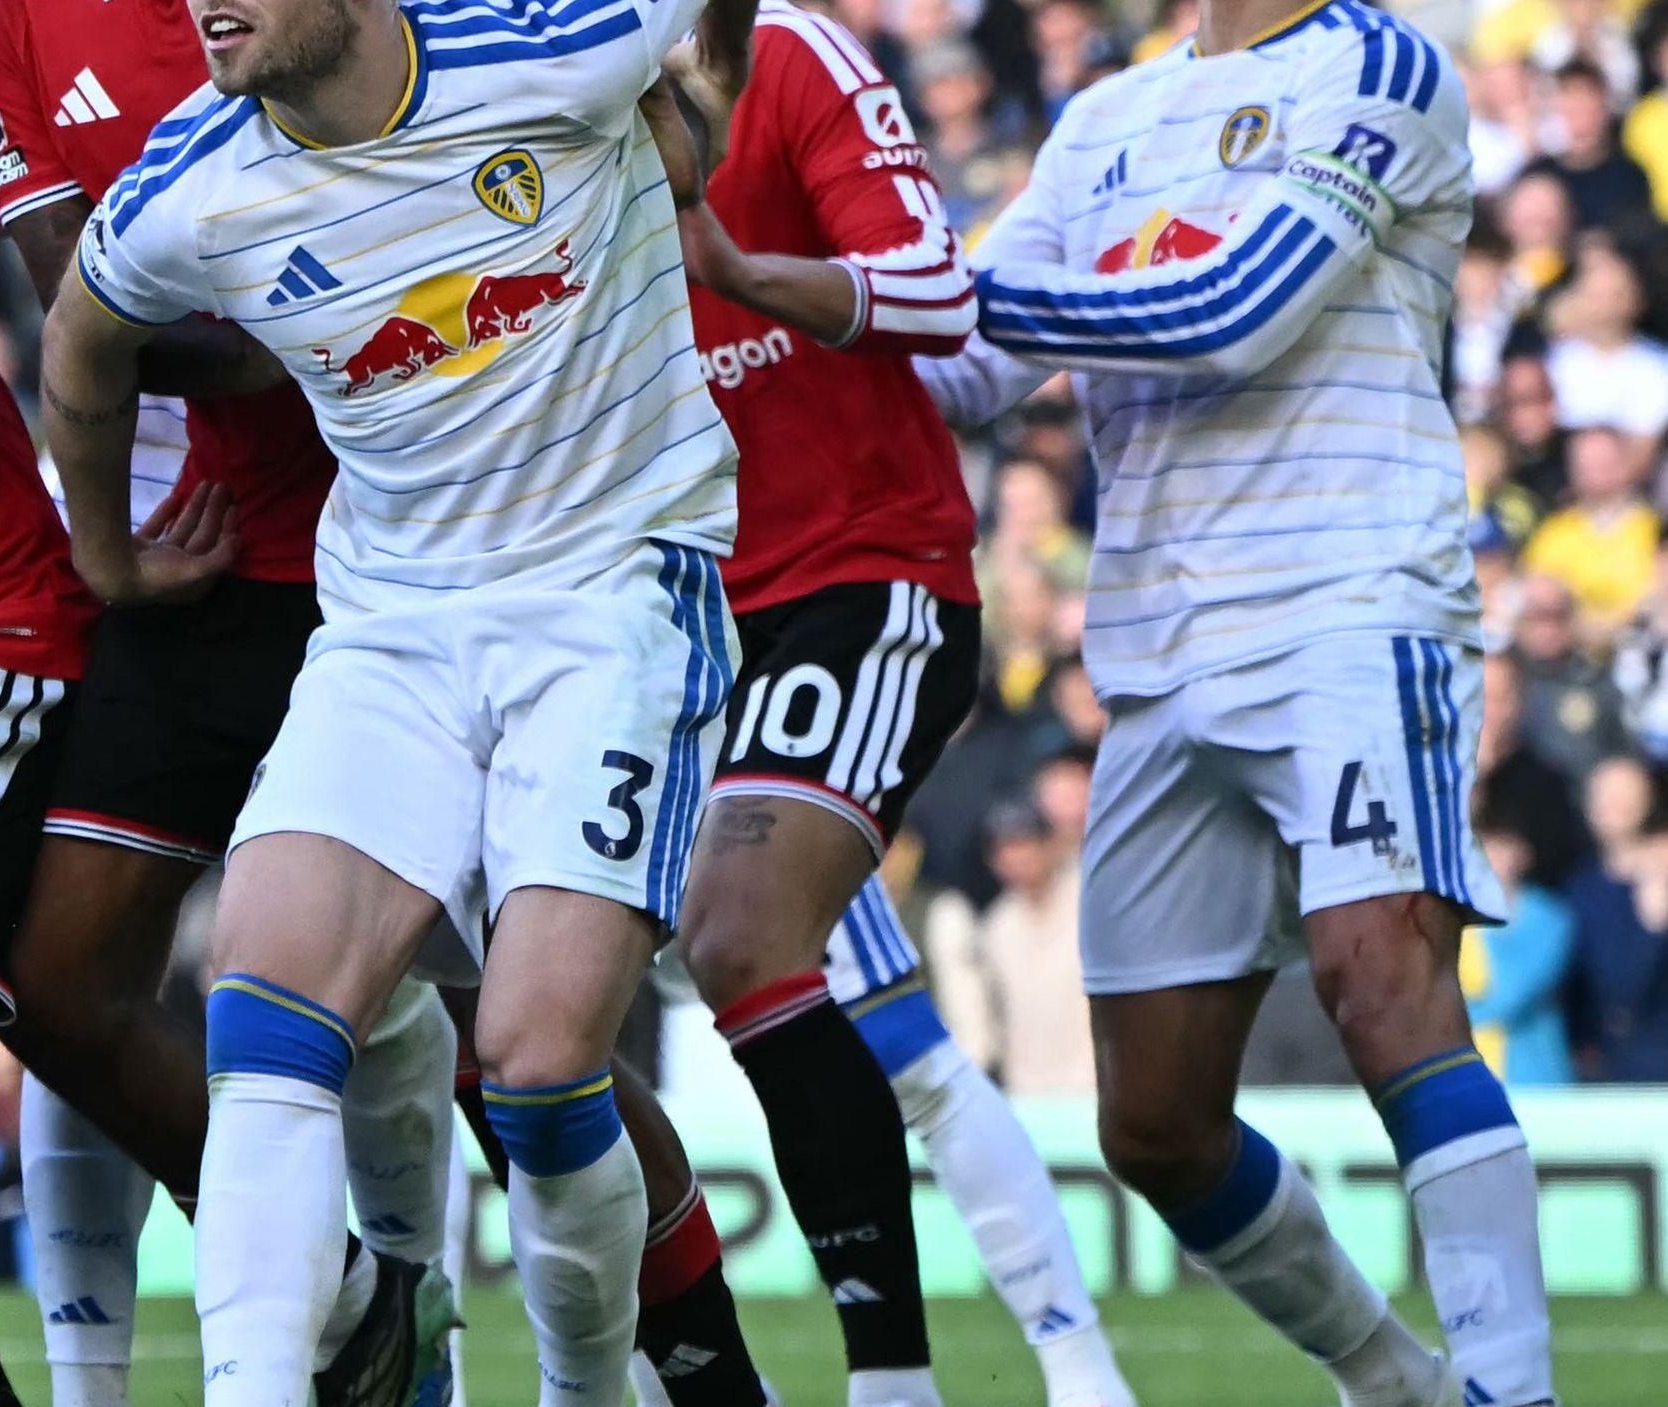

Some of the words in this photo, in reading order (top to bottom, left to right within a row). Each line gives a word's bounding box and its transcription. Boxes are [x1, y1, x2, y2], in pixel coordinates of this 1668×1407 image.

[1288, 159, 1377, 213] Captain
[729, 661, 843, 764] 10
[581, 749, 655, 862] 3
[1330, 760, 1398, 857] 4
